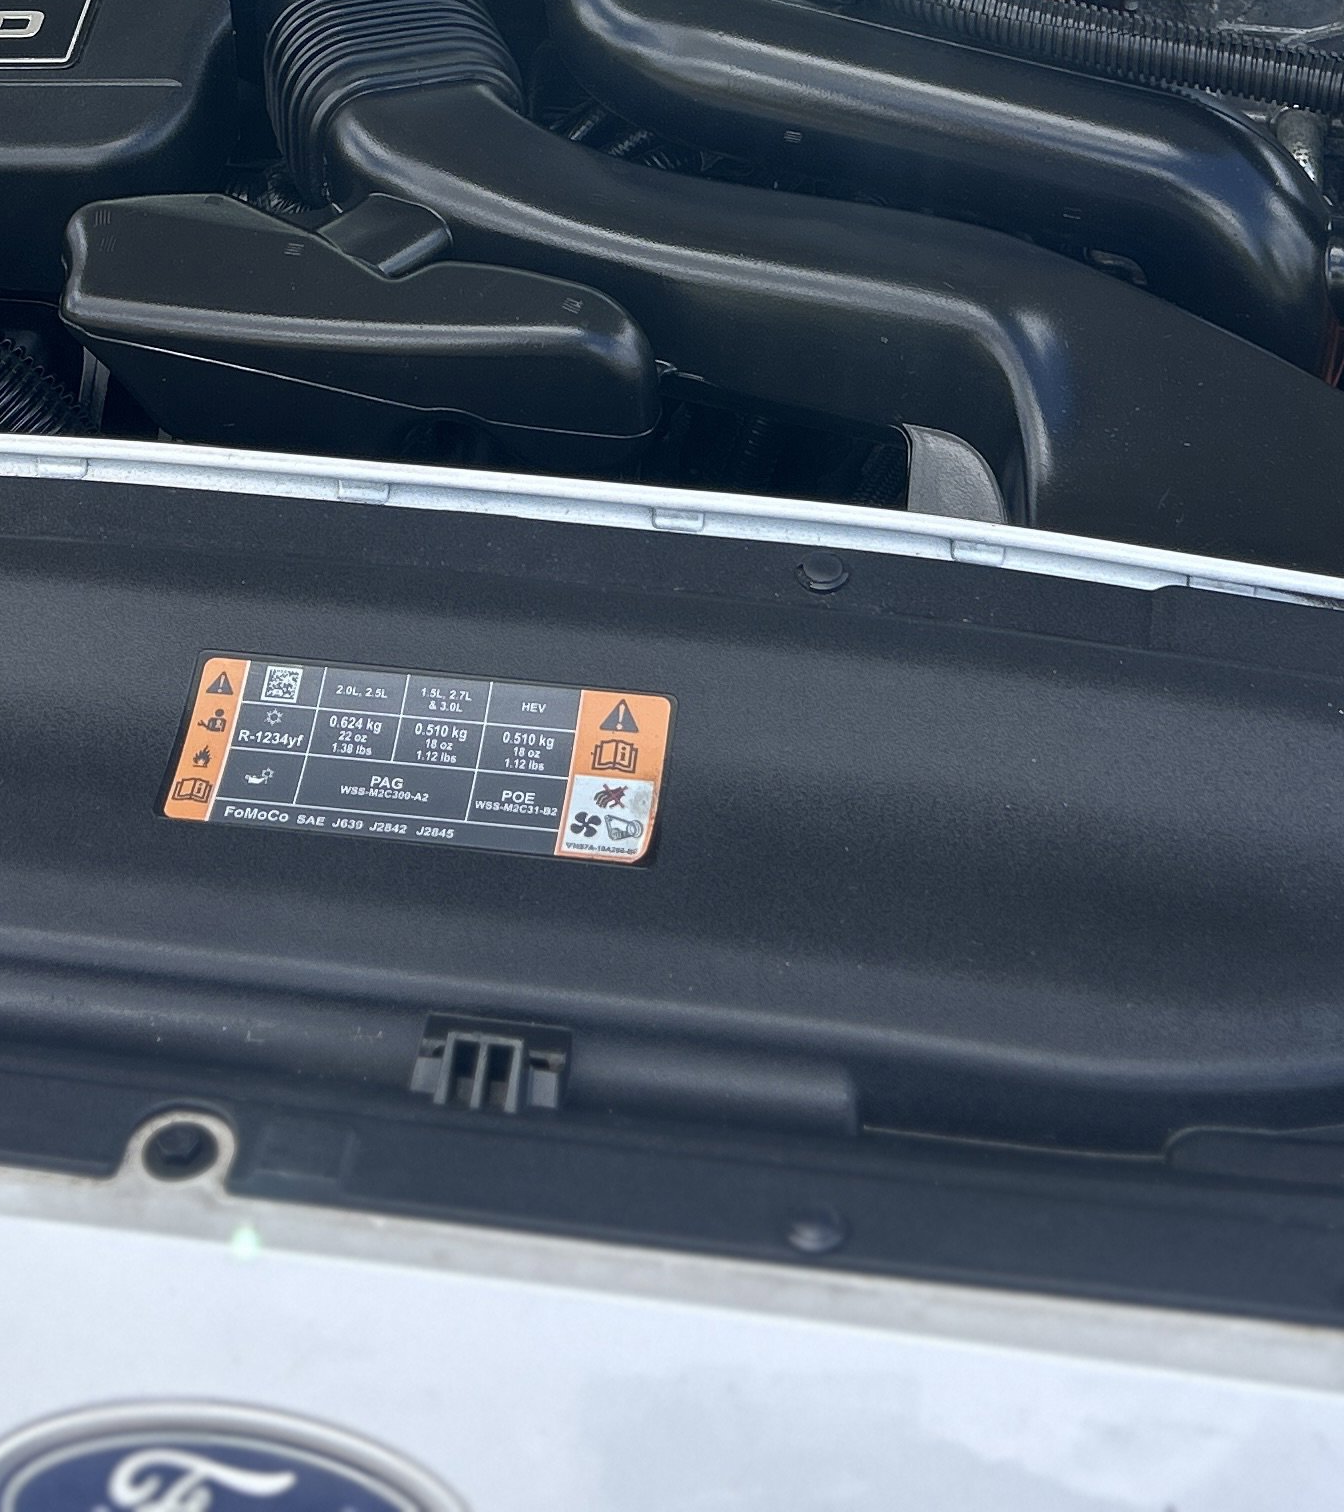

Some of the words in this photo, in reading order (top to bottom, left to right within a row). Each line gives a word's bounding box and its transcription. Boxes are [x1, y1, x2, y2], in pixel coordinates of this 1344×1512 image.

[336, 685, 361, 696] 2.0L,
[365, 688, 387, 698] 2.5L
[422, 688, 445, 699] 1.5L,
[450, 690, 472, 701] 2.7L
[429, 700, 436, 709] &
[440, 702, 462, 712] 3.0L
[522, 702, 546, 713] HEV
[330, 715, 363, 729] 0.624
[366, 719, 382, 734] kg
[415, 721, 450, 737] 0.510
[452, 726, 467, 741] kg
[238, 730, 304, 748] R-1234yf
[338, 731, 352, 741] 22
[354, 734, 367, 742] oz
[503, 732, 535, 745] 0.510
[539, 735, 554, 750] kg
[333, 743, 353, 753] 1.38
[356, 745, 371, 755] lbs
[426, 739, 437, 749] 18
[440, 742, 453, 750] oz
[417, 750, 438, 761] 1.12
[440, 752, 456, 763] lbs
[514, 747, 525, 757] 18
[528, 750, 540, 758] oz
[505, 758, 526, 769] 1.12
[529, 760, 544, 770] lbs
[370, 776, 403, 789] PAG
[341, 785, 428, 801] WSS-M2C300-A2
[502, 791, 535, 803] POE
[476, 800, 557, 816] WSS-M2C31-B2
[224, 805, 290, 822] FoMoCo
[297, 815, 325, 826] SAE
[332, 819, 363, 829] J639
[369, 823, 407, 834] J2842
[416, 827, 454, 838] J2845
